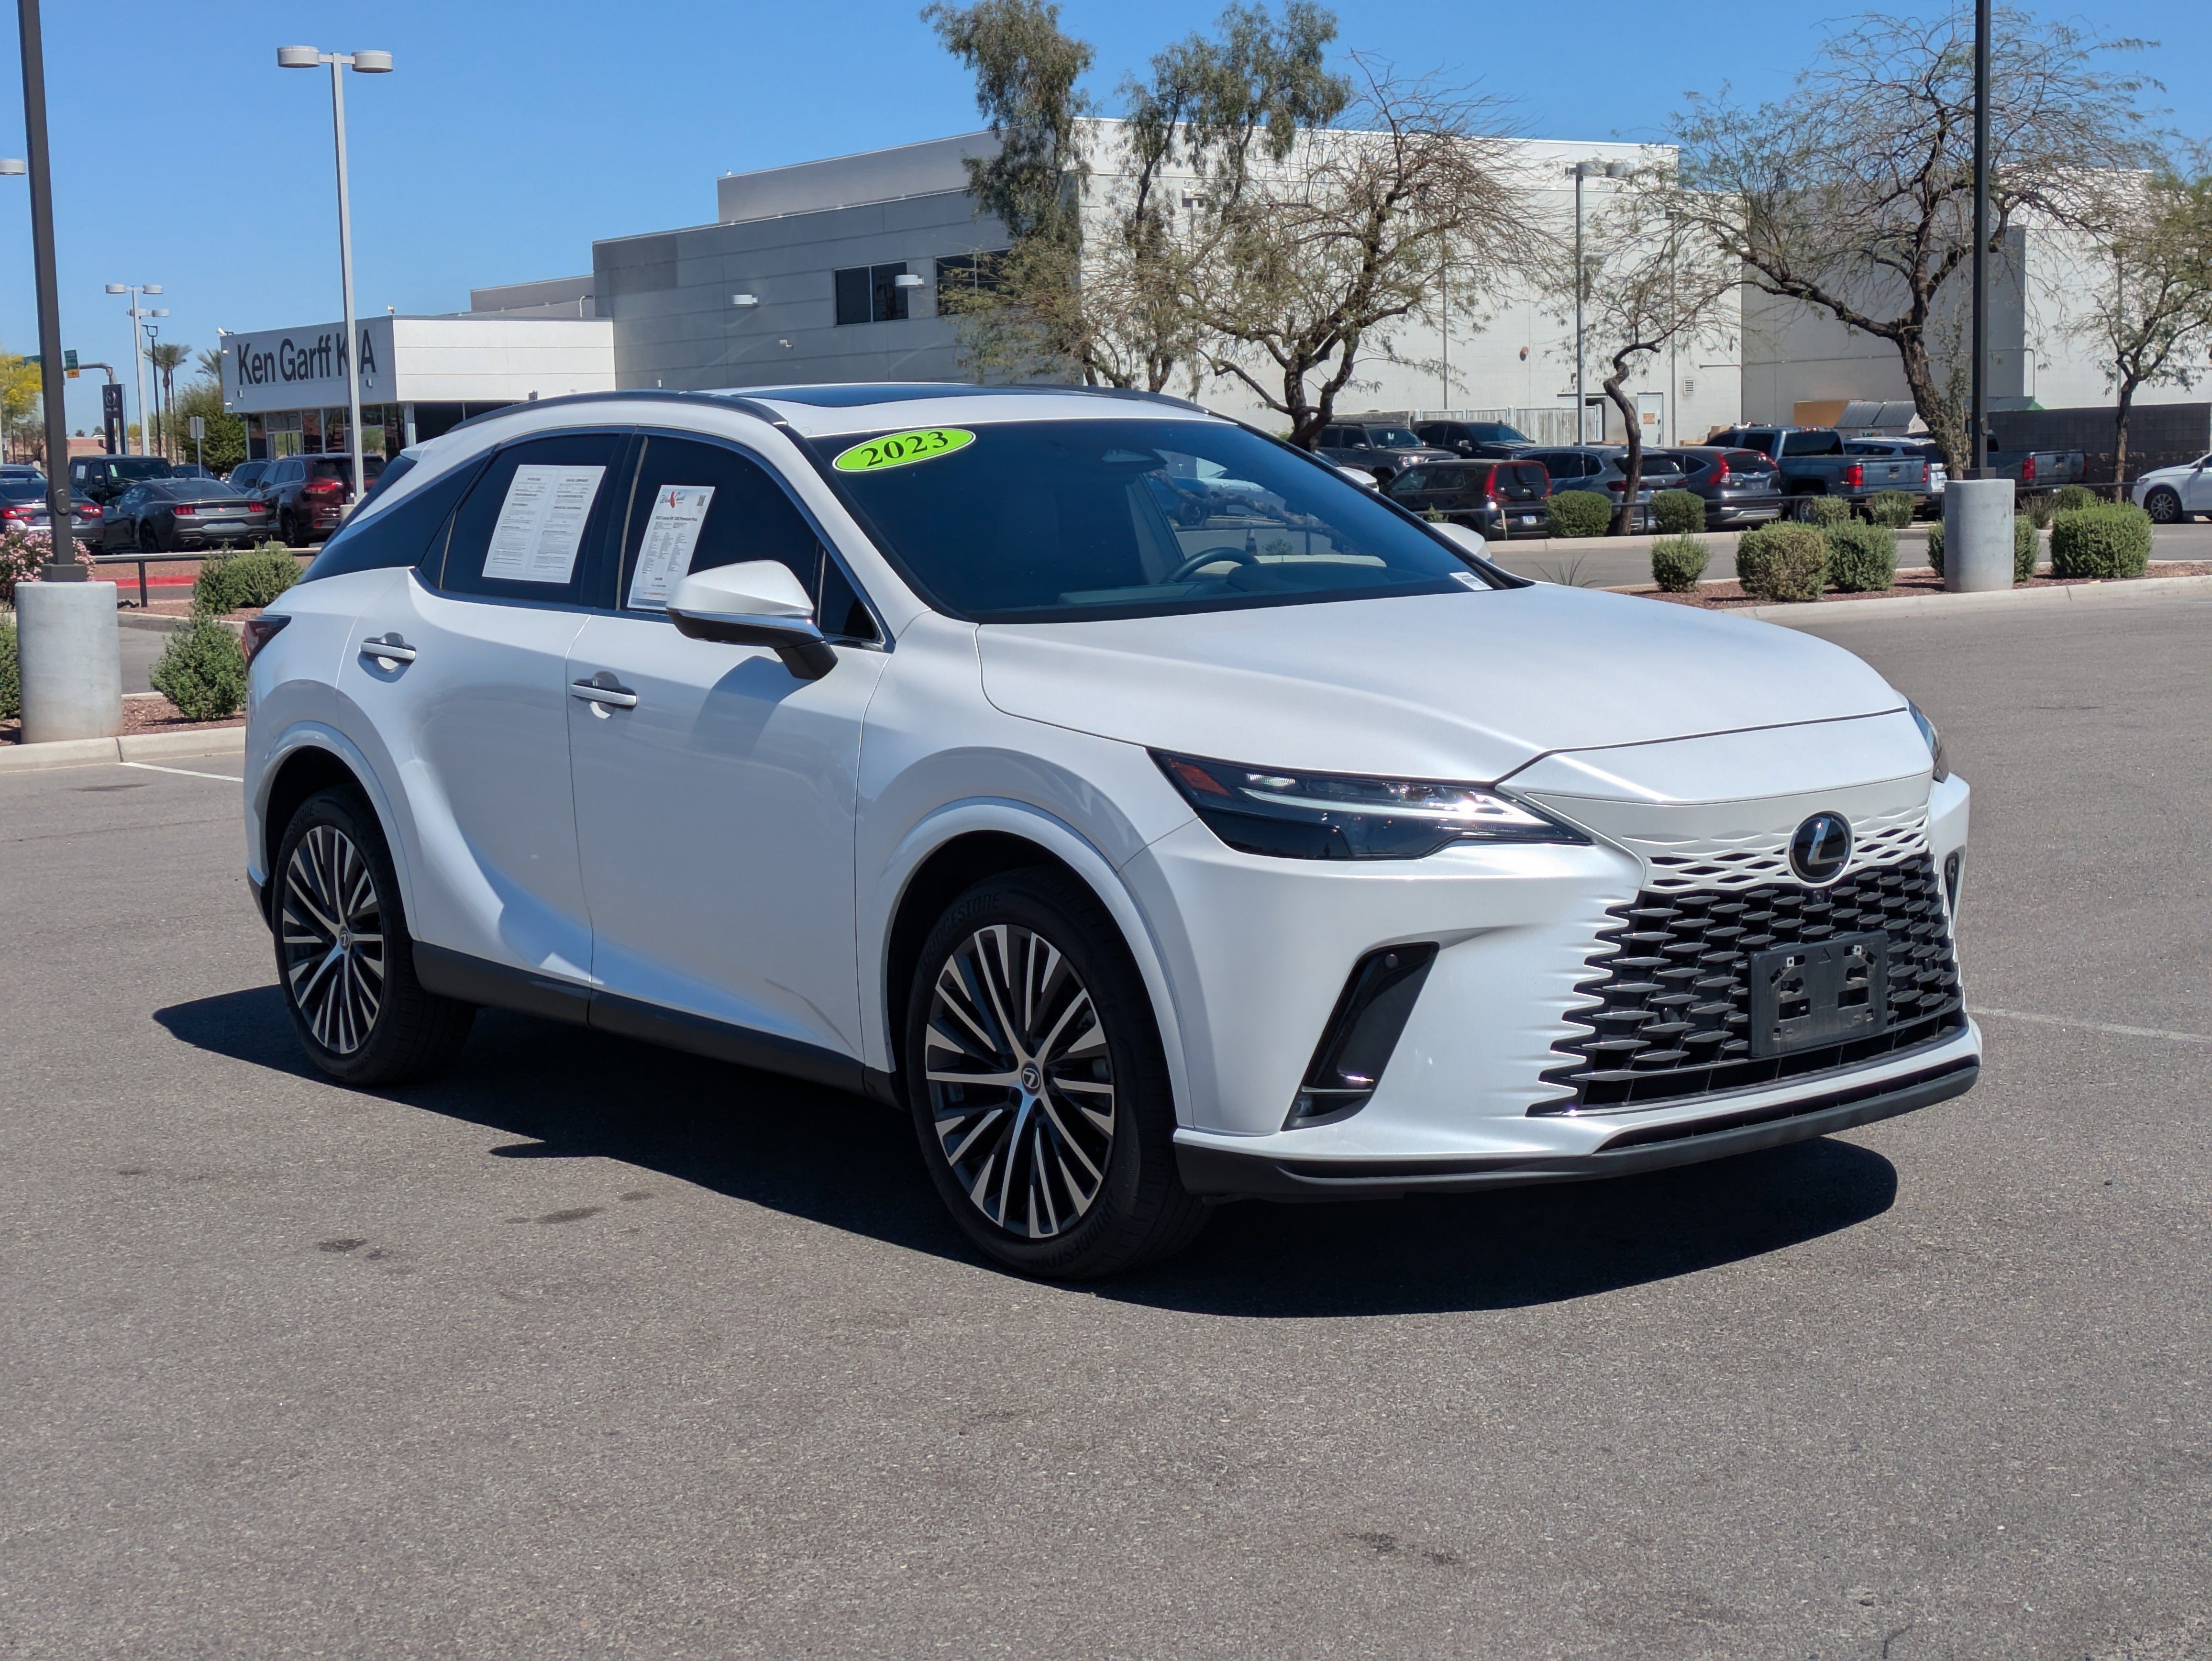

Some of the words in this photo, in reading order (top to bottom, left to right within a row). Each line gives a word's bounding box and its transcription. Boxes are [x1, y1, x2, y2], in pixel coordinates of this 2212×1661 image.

[237, 343, 276, 385] Ken
[279, 334, 331, 381] Garff
[336, 329, 376, 376] KA
[861, 431, 949, 467] 2023
